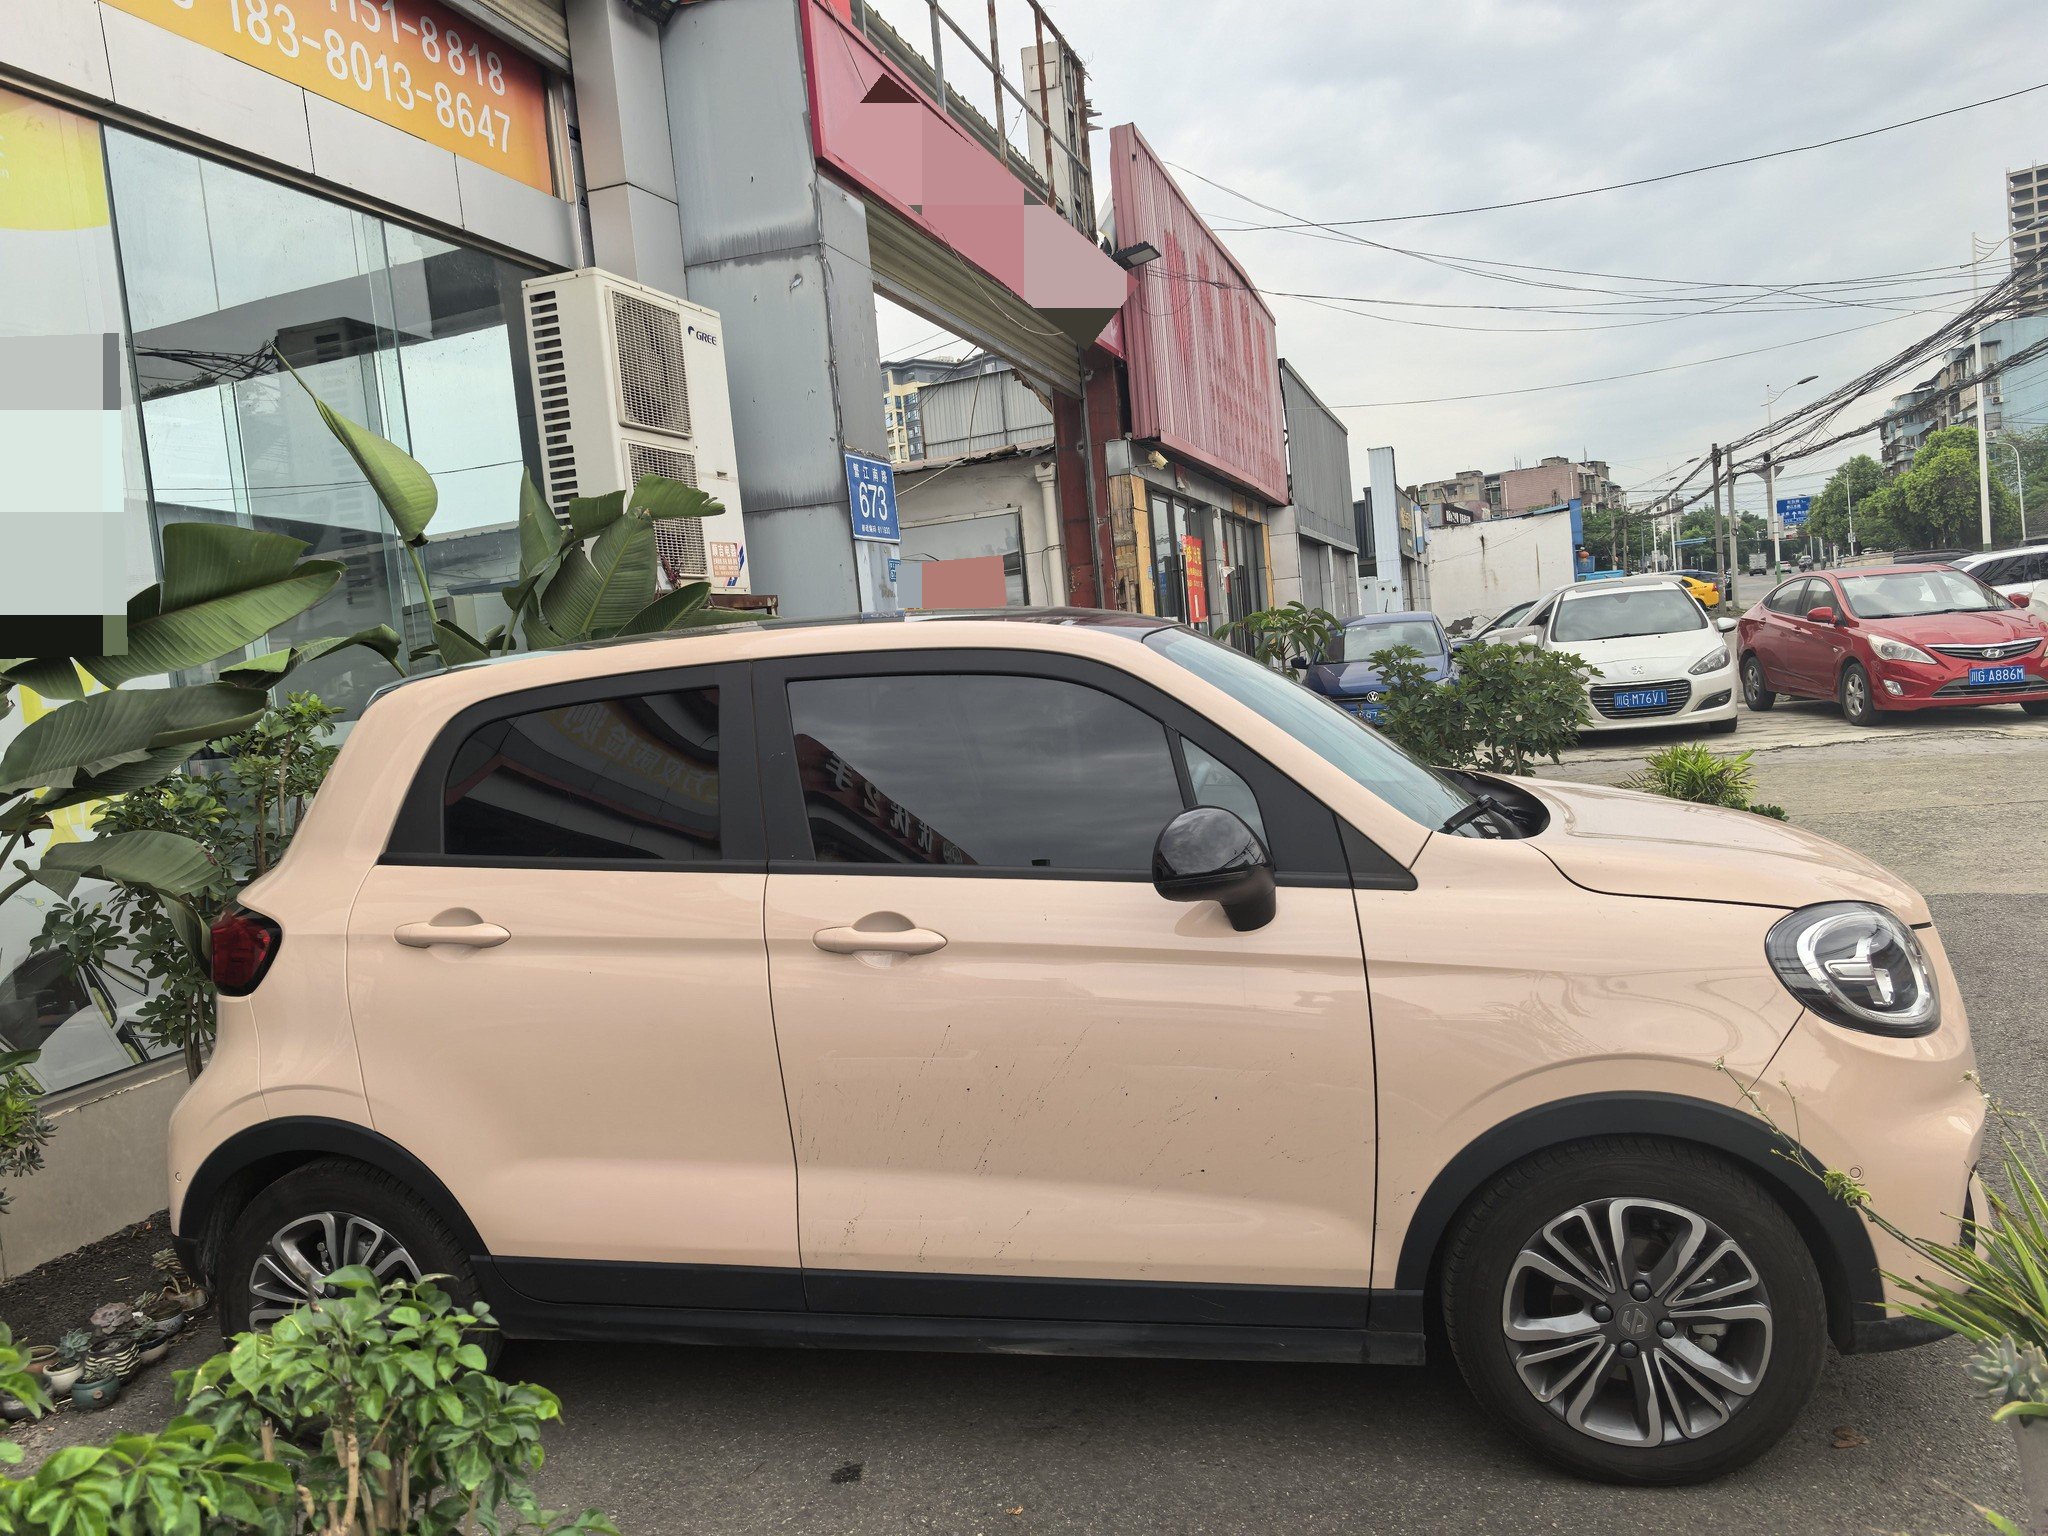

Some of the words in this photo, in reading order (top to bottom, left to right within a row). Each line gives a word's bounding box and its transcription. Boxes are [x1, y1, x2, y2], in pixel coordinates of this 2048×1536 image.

[330, 0, 506, 96] 51-8818
[696, 330, 717, 346] GREE
[859, 482, 888, 521] 673
